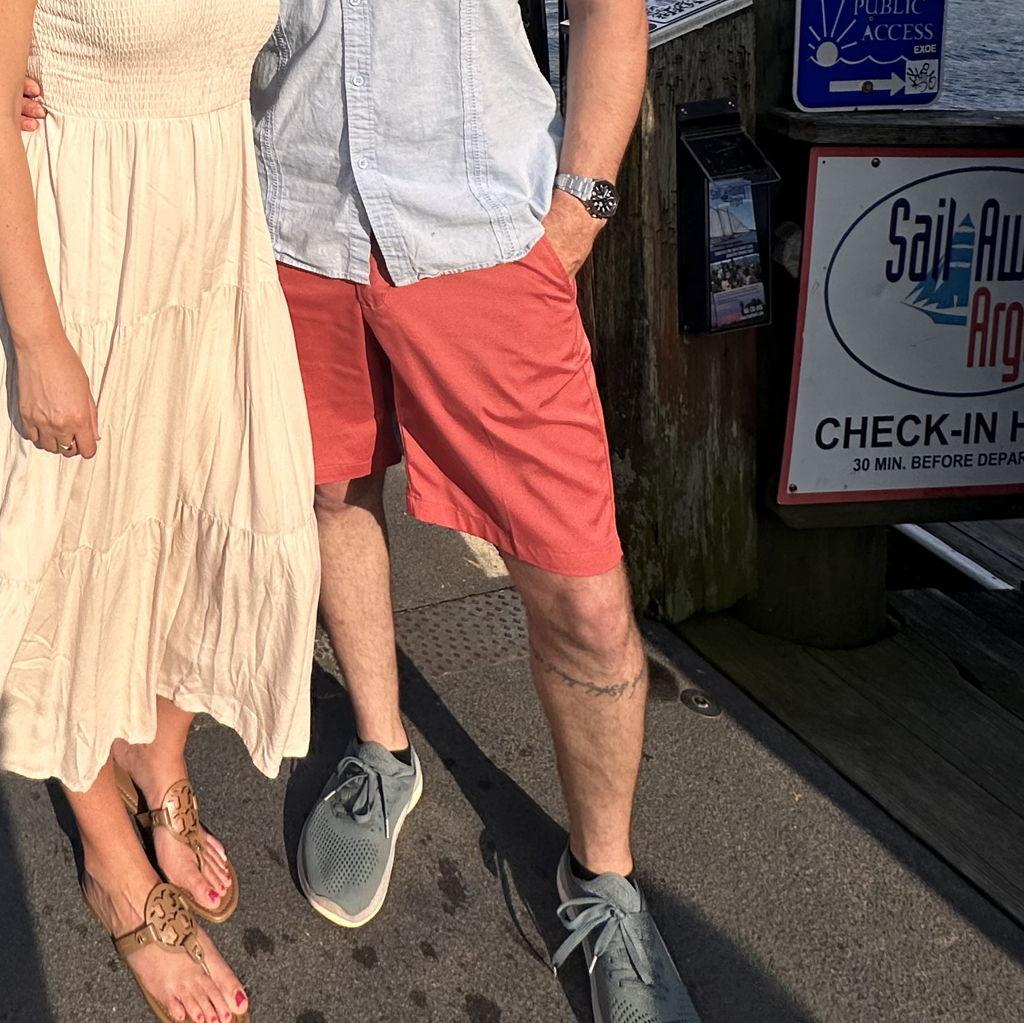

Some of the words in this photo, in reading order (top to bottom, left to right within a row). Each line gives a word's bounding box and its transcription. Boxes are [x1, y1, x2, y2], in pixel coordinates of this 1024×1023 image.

[862, 23, 934, 41] ACCESS
[885, 197, 957, 283] Sail
[966, 286, 1024, 383] Arg
[815, 411, 998, 450] CHECK-IN
[852, 458, 870, 472] 30
[874, 456, 906, 471] MIN.
[911, 454, 974, 469] BEFORE
